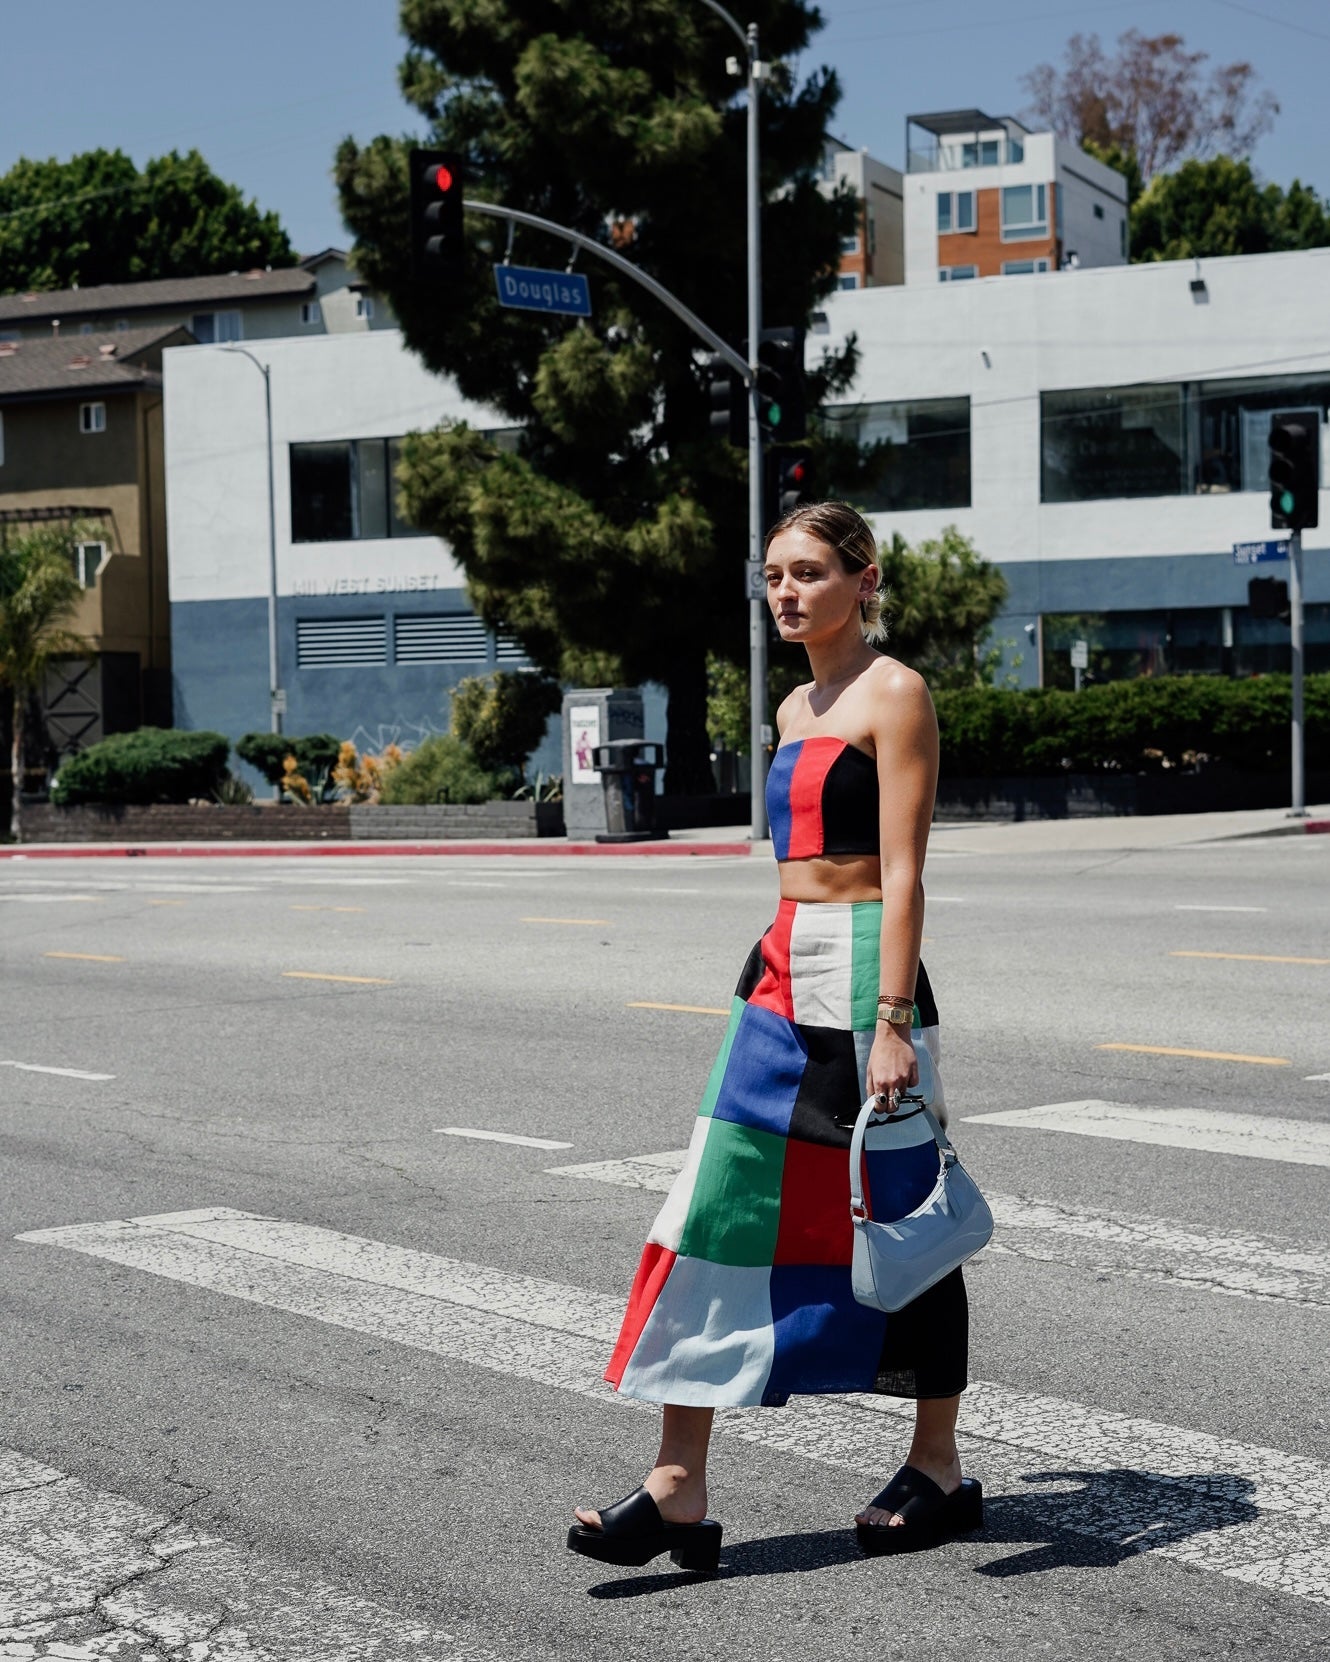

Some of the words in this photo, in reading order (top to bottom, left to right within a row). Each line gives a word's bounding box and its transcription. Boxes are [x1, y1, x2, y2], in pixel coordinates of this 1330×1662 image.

[504, 275, 582, 307] Douglas
[322, 576, 370, 597] WEST
[376, 573, 439, 595] SUNSET
